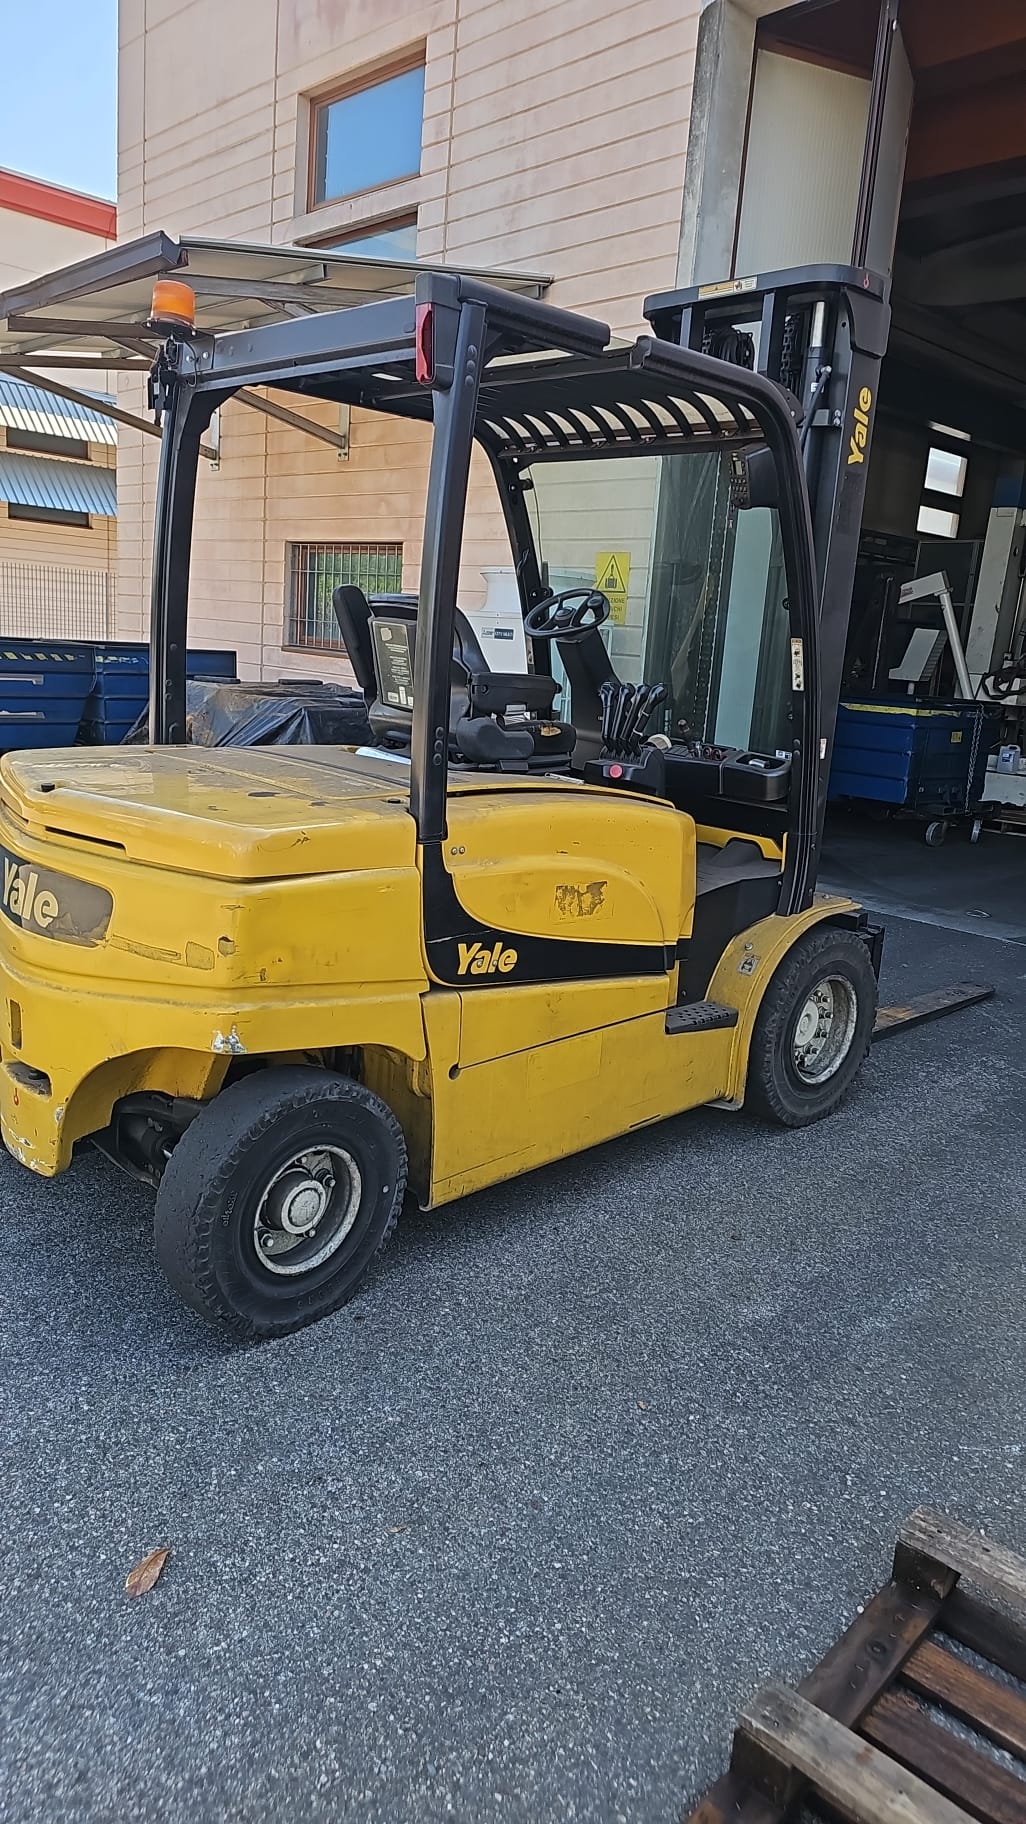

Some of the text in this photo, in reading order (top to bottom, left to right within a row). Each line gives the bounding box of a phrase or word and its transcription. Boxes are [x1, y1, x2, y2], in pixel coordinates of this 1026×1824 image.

[847, 386, 872, 465] Yale
[3, 856, 59, 928] Yale
[457, 941, 518, 975] Yale
